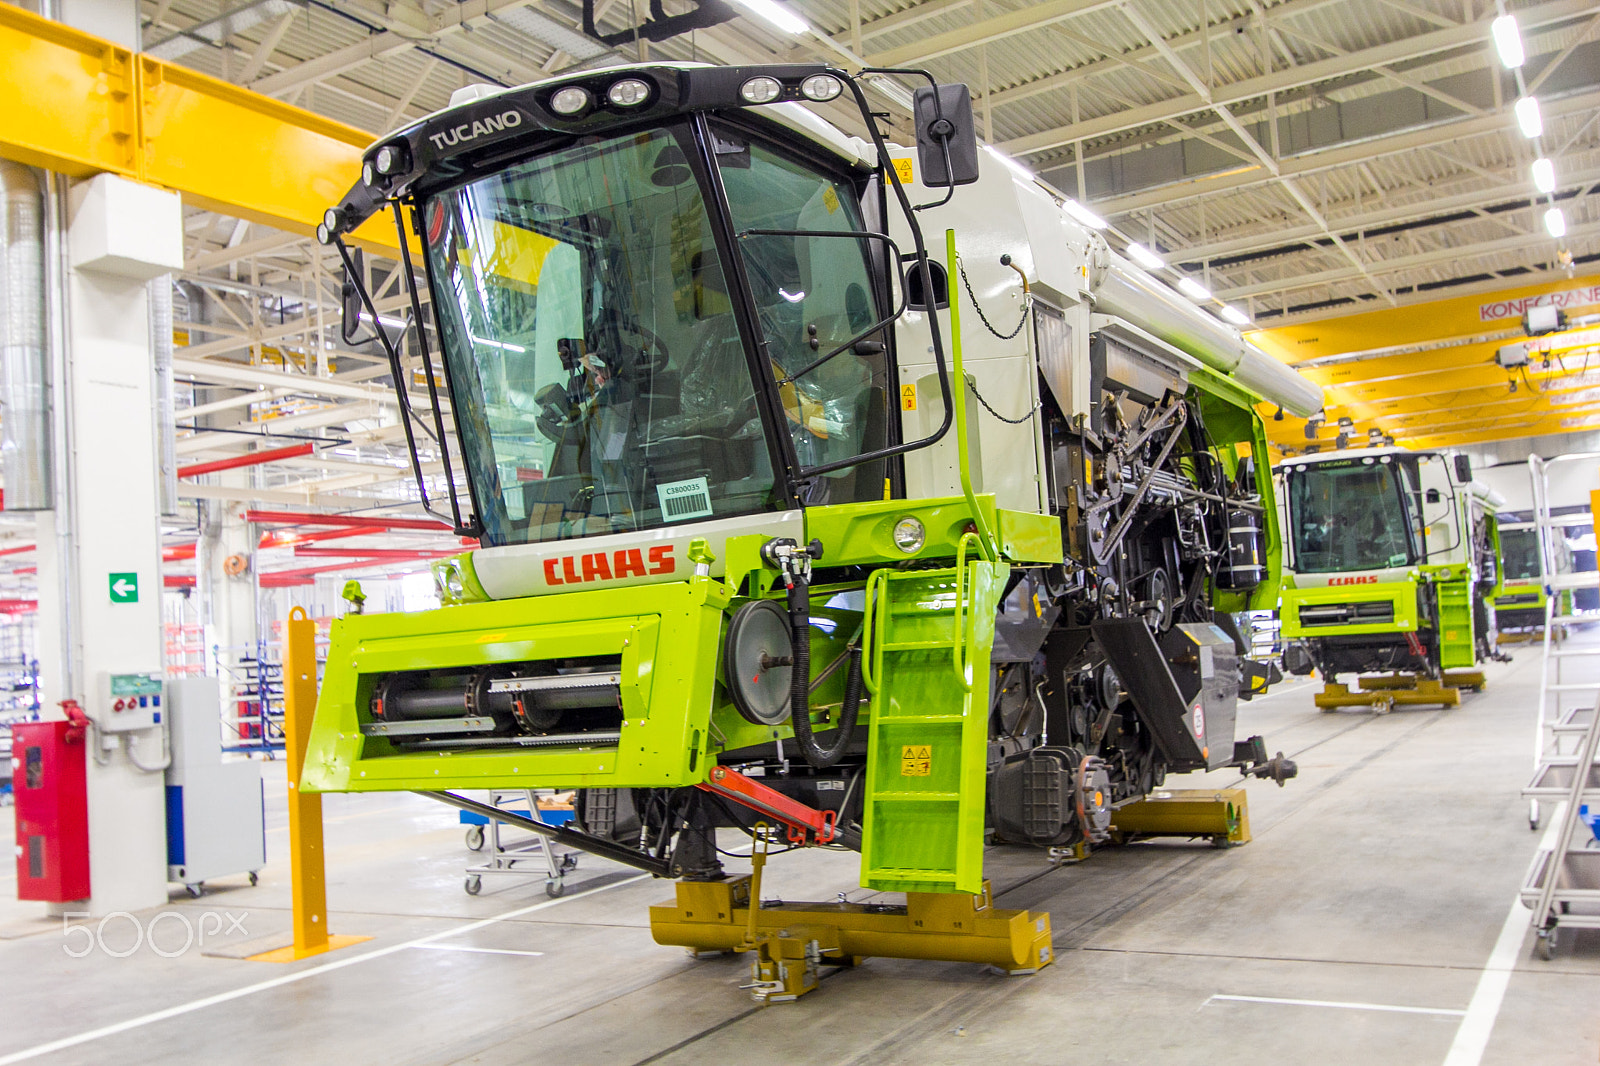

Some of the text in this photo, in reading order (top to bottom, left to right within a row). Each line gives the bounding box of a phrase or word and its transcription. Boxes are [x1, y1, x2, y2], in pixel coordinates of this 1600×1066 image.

[429, 110, 521, 149] TUCANO
[666, 483, 700, 495] C3800035
[543, 545, 675, 586] CLAAS
[1328, 575, 1378, 586] CLAAS
